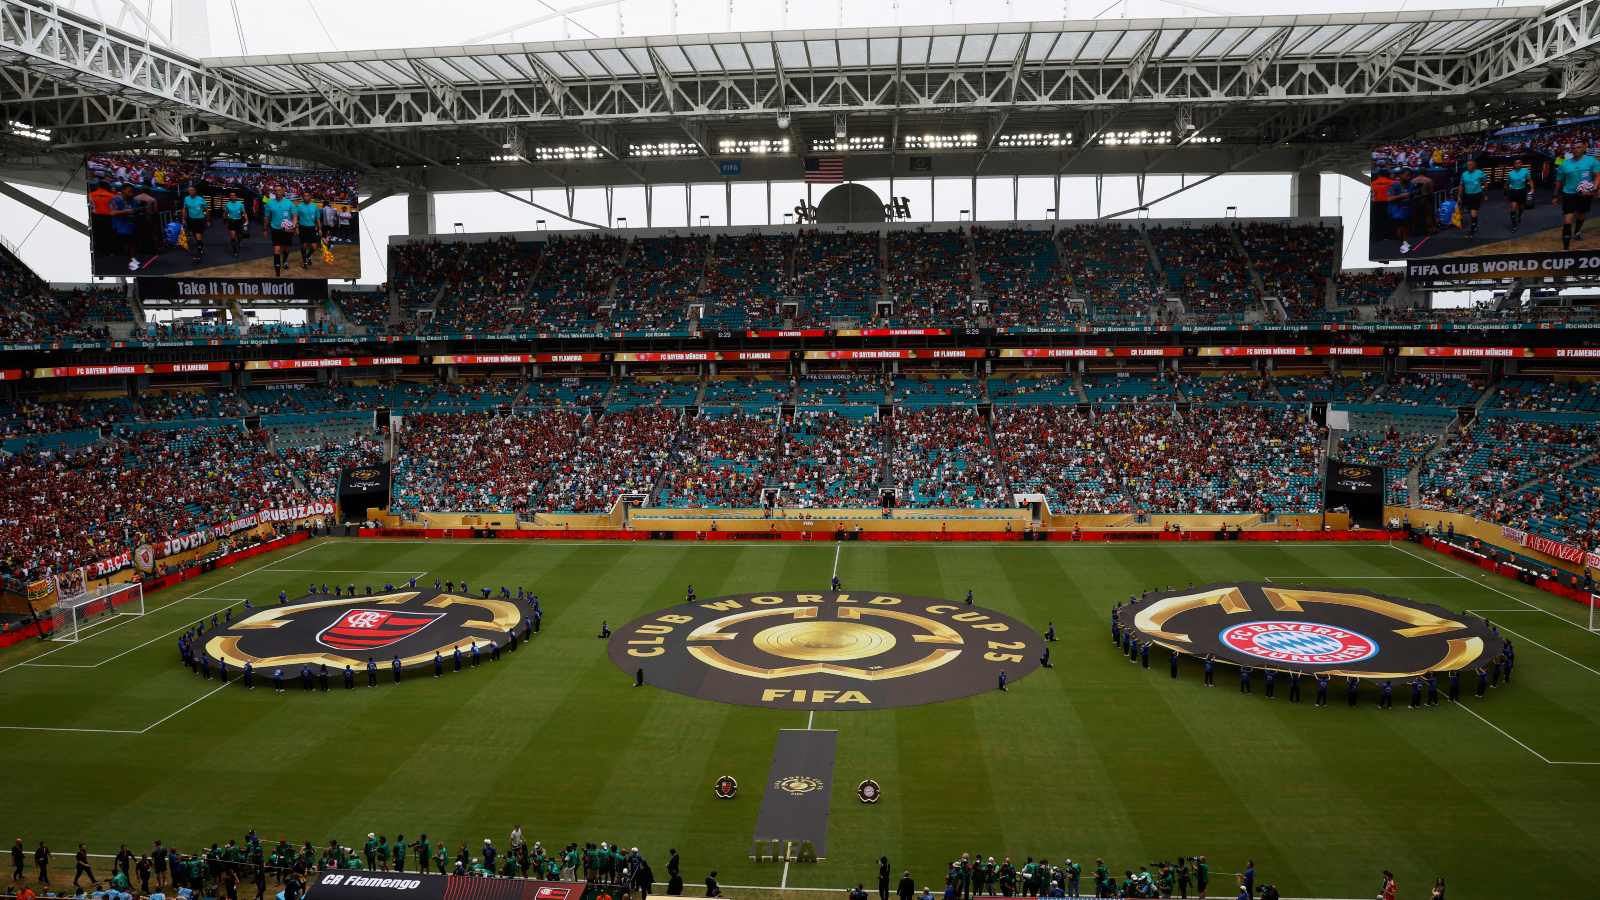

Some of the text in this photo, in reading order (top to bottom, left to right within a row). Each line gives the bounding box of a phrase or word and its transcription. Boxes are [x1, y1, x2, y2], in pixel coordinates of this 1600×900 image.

[1410, 265, 1439, 276] FIFA
[1442, 263, 1479, 275] CLUB
[1482, 259, 1538, 272] WORLD
[1542, 258, 1574, 270] CUP
[178, 282, 294, 295] Take It To The World
[108, 365, 135, 373] MÜNCHEN
[258, 502, 334, 524] URUBUZADA
[164, 530, 207, 557] JOVEM
[97, 553, 130, 576] RAÇA
[628, 594, 1026, 663] CLUB WORLD CUP 25
[1230, 624, 1367, 663] FC BAYERN MÜNCHEN
[762, 690, 872, 704] FIFA
[755, 839, 818, 862] FIFA
[321, 874, 420, 889] CR Flamengo
